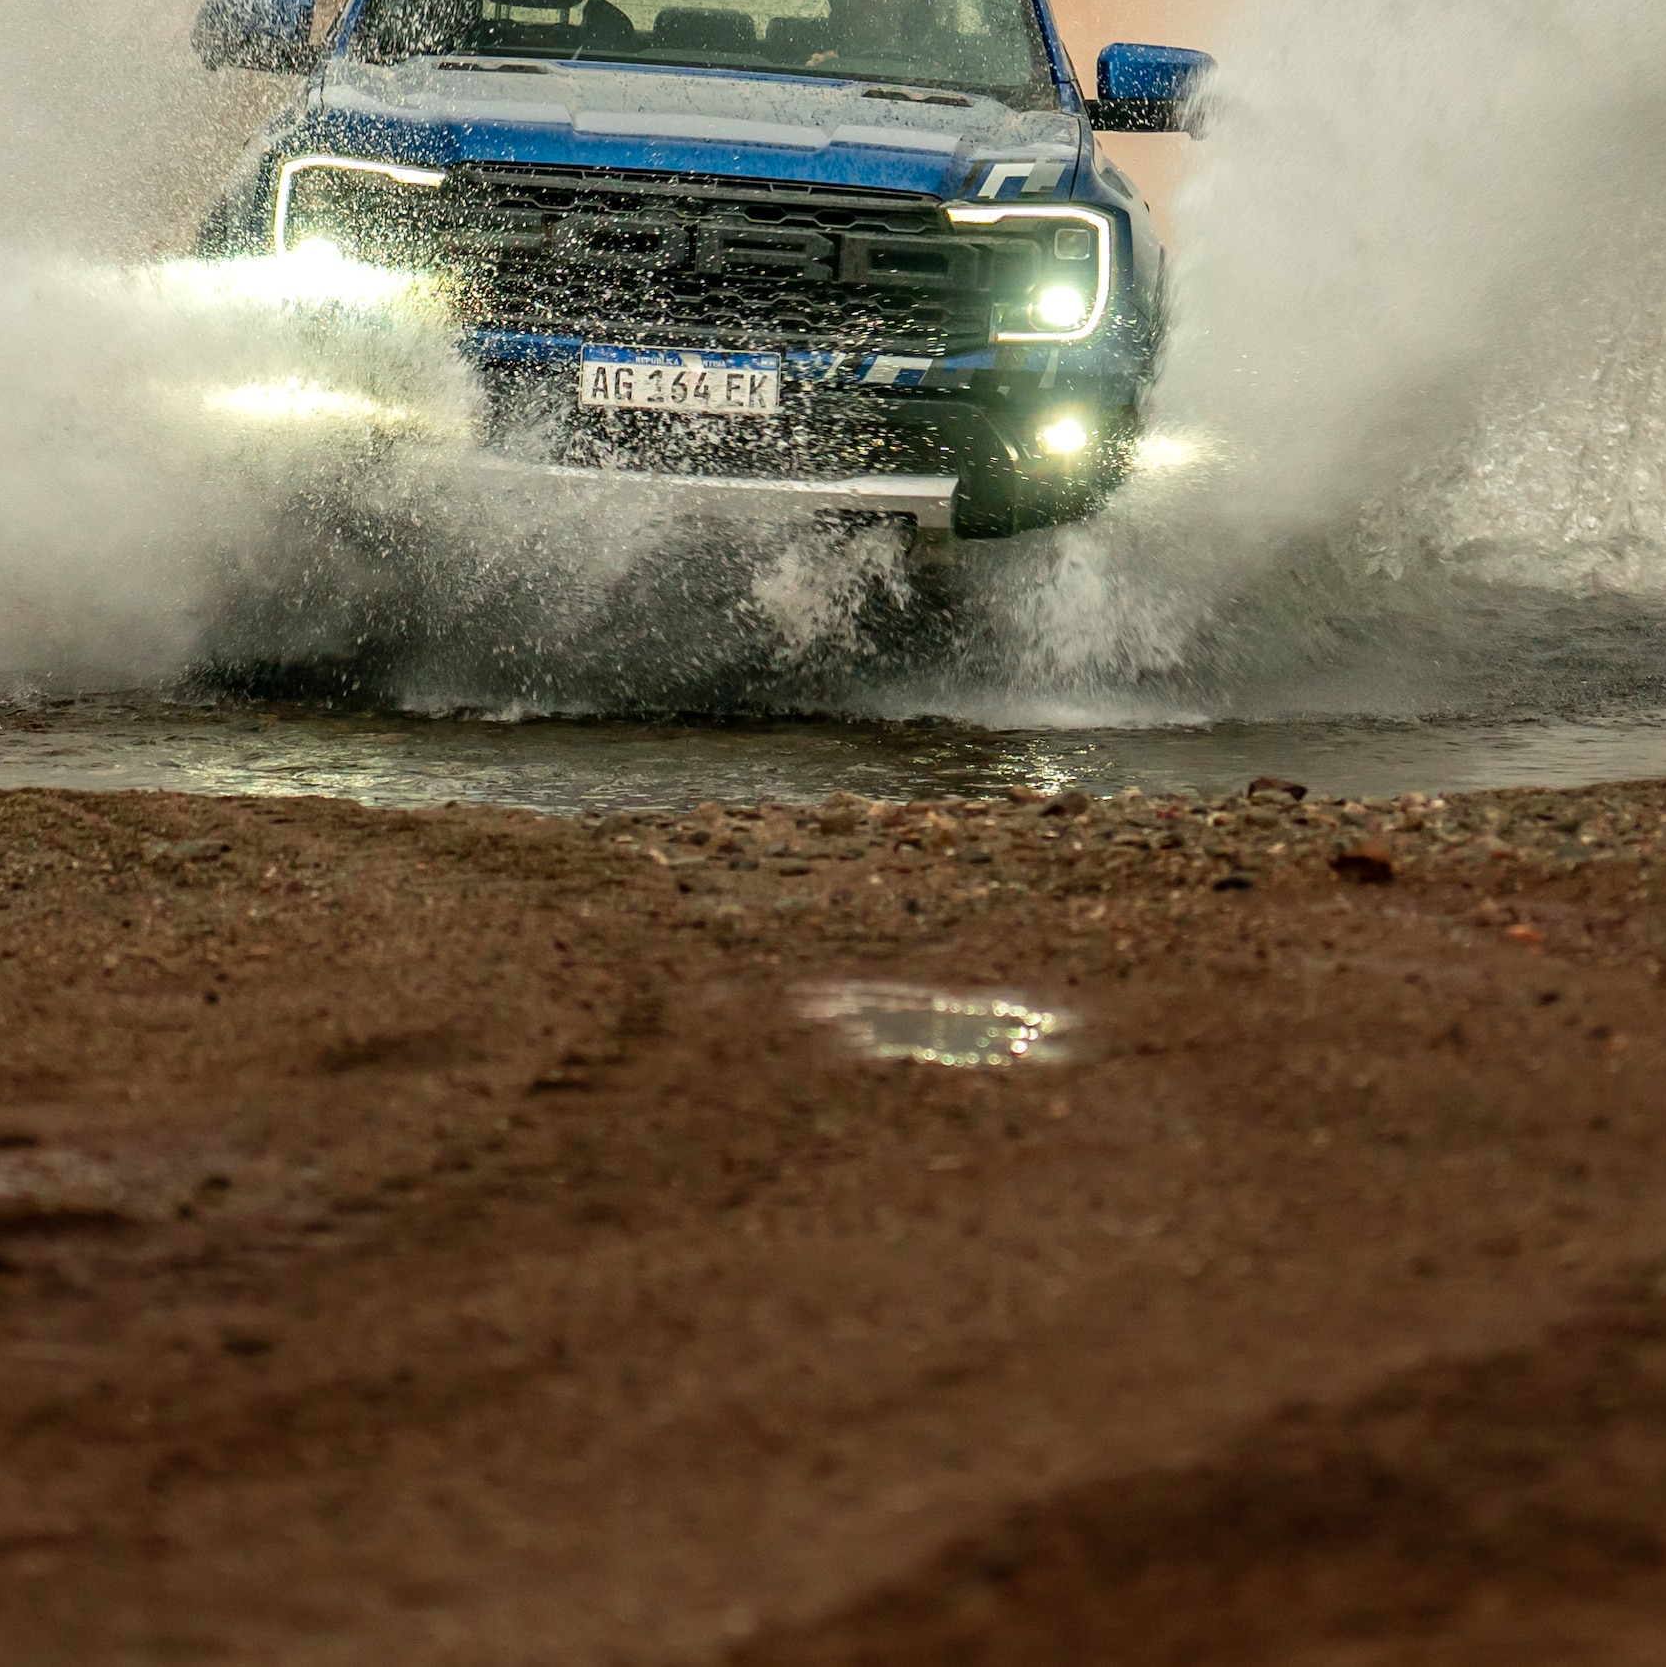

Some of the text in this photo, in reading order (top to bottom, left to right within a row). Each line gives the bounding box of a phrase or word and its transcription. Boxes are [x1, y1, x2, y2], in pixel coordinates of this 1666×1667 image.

[680, 359, 727, 368] NTINA
[591, 366, 634, 402] AG
[725, 373, 768, 408] EK
